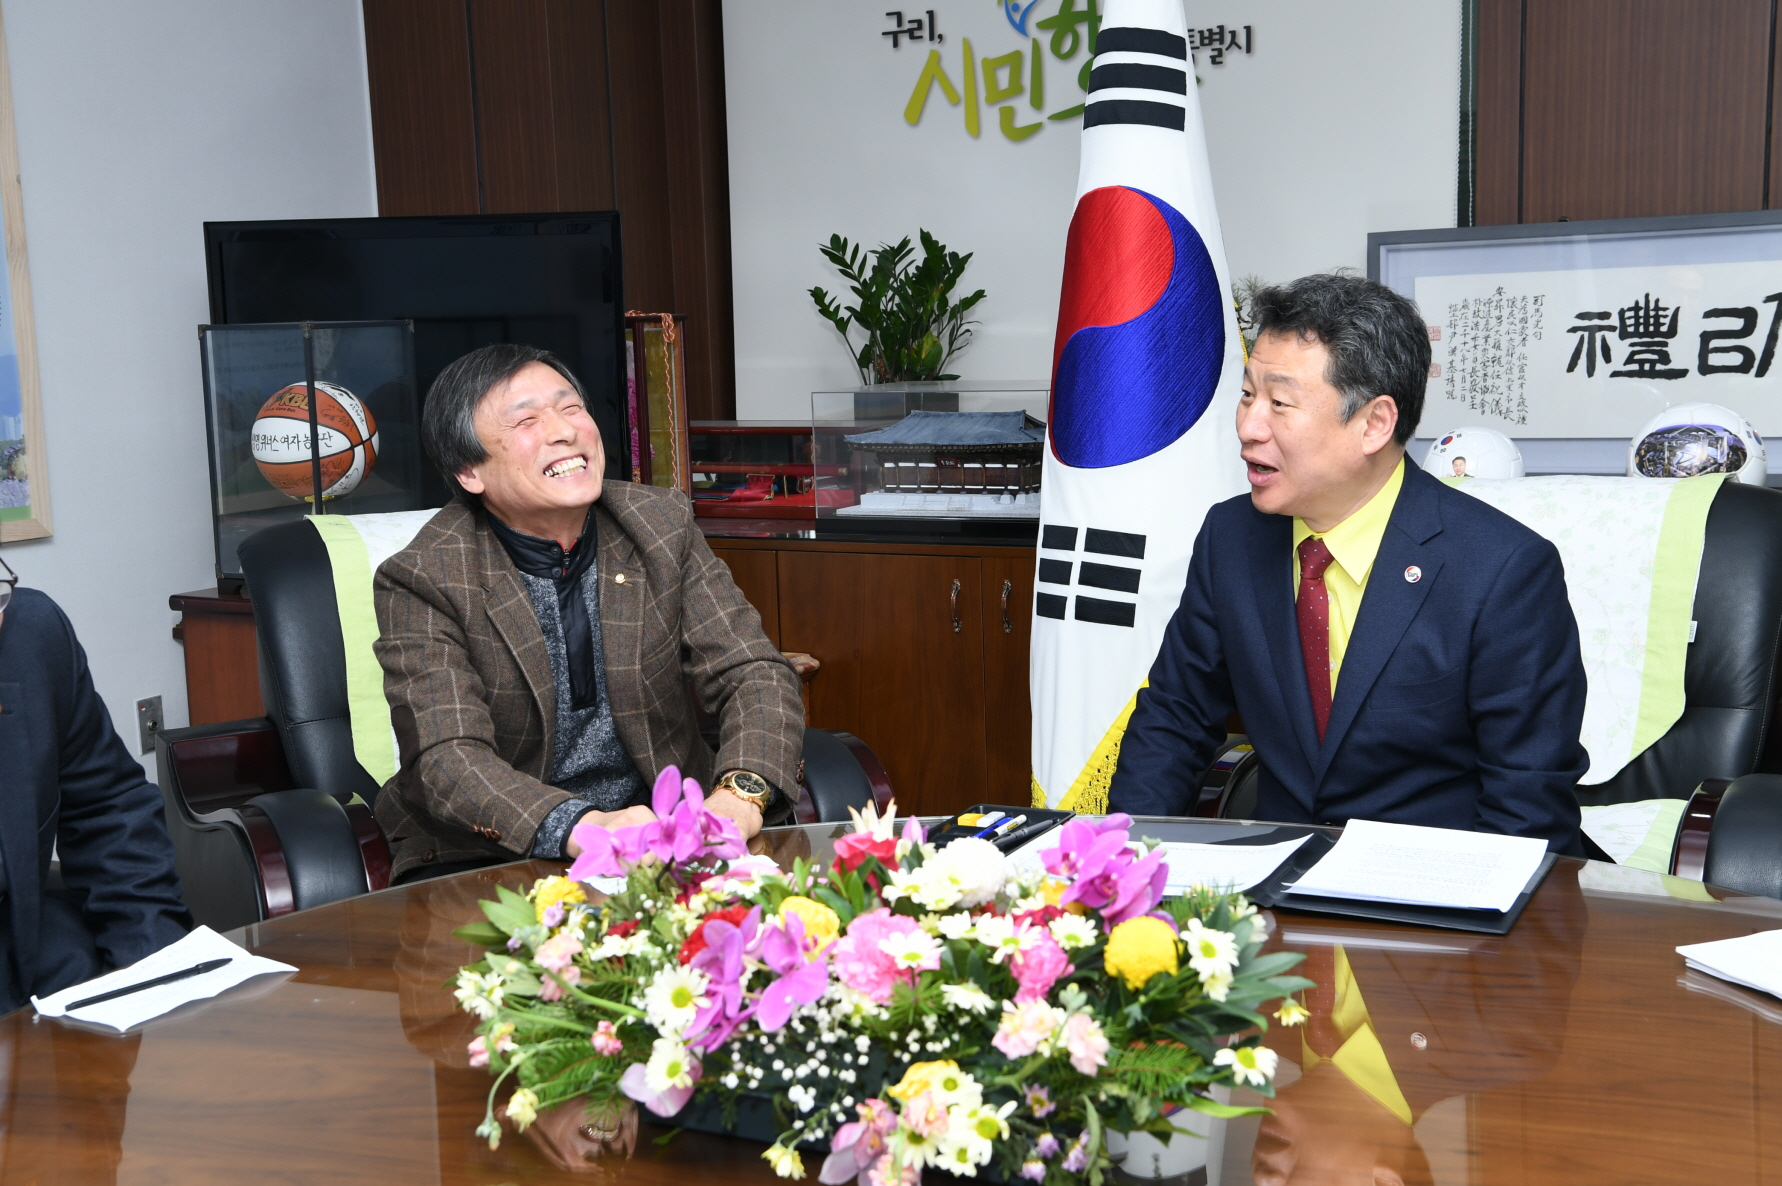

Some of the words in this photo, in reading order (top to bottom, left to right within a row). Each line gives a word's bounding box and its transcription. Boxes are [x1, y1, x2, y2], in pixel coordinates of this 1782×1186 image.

[881, 10, 943, 49] 구리,
[280, 433, 301, 451] 여자
[303, 431, 333, 449] 농단
